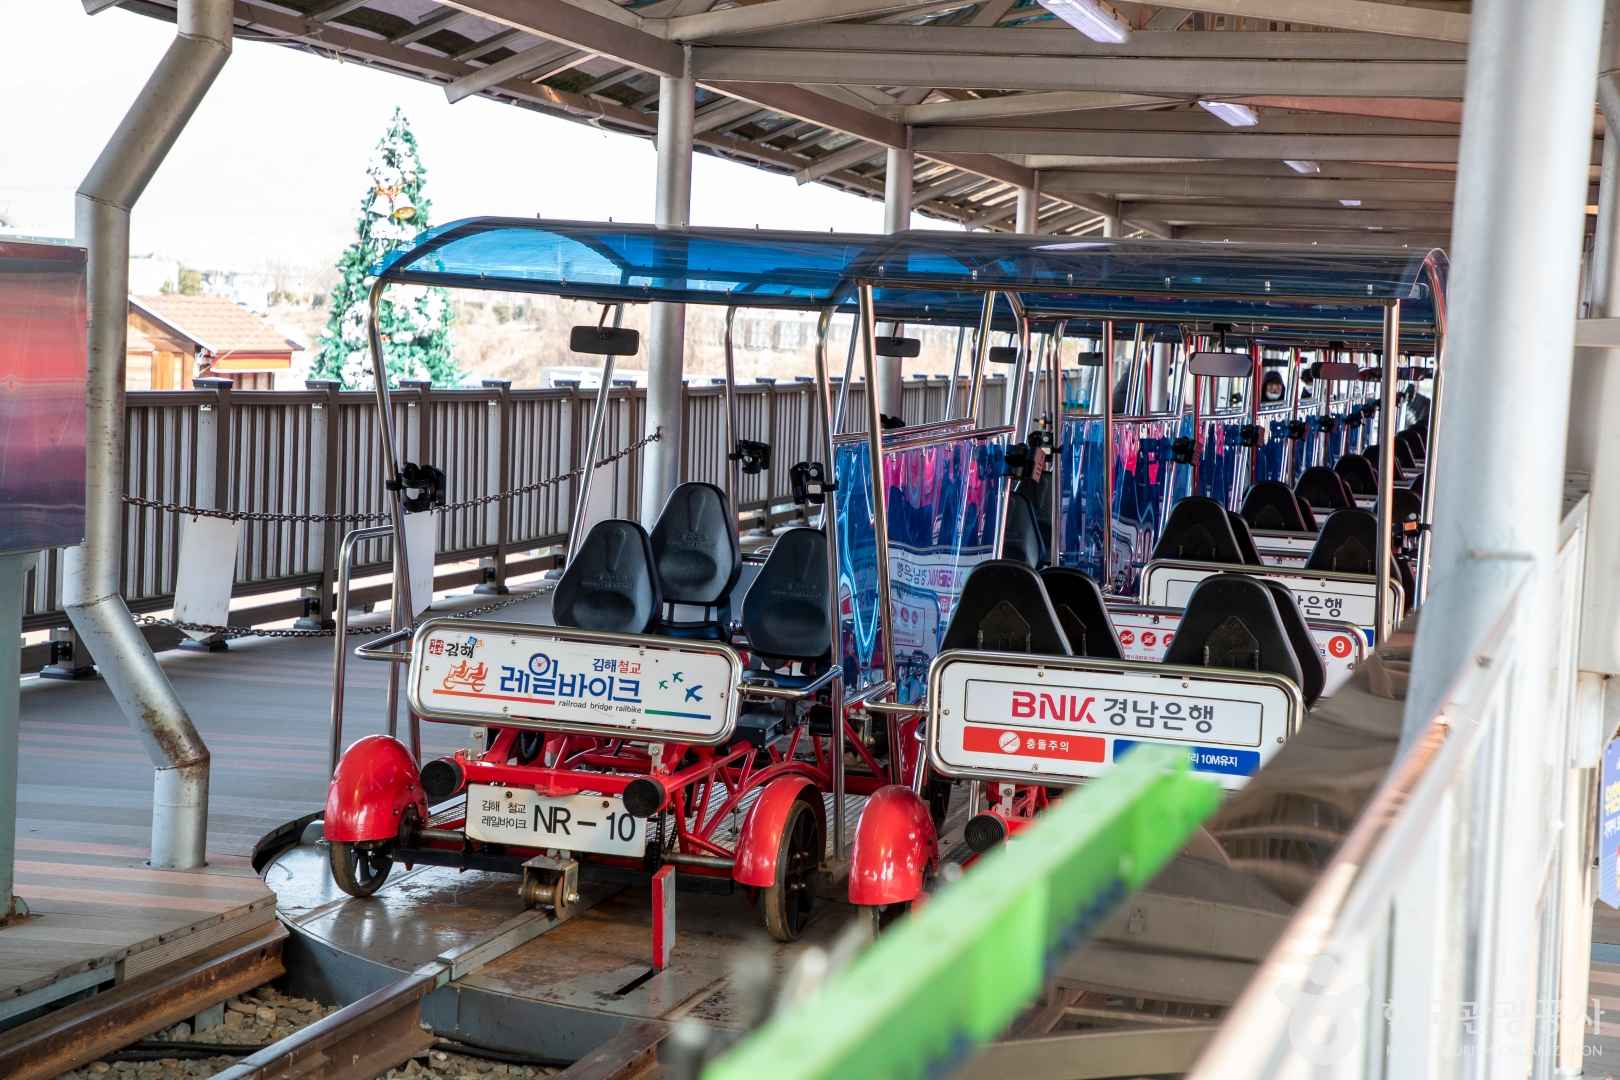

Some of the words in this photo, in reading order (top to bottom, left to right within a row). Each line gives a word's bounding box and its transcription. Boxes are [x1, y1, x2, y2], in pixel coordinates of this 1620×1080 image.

[1298, 595, 1343, 618] 은행
[445, 643, 475, 658] 김해
[1335, 640, 1345, 653] 9
[500, 652, 642, 703] 레일바이크
[558, 700, 587, 709] railroad
[590, 703, 612, 712] bridge
[615, 704, 642, 714] railbike
[1011, 690, 1096, 724] BNK
[1103, 697, 1214, 734] 경남은행
[481, 800, 500, 812] 김해
[508, 802, 527, 813] 철교
[481, 815, 528, 829] 레일바이크
[533, 804, 572, 835] NR
[606, 812, 636, 842] 10
